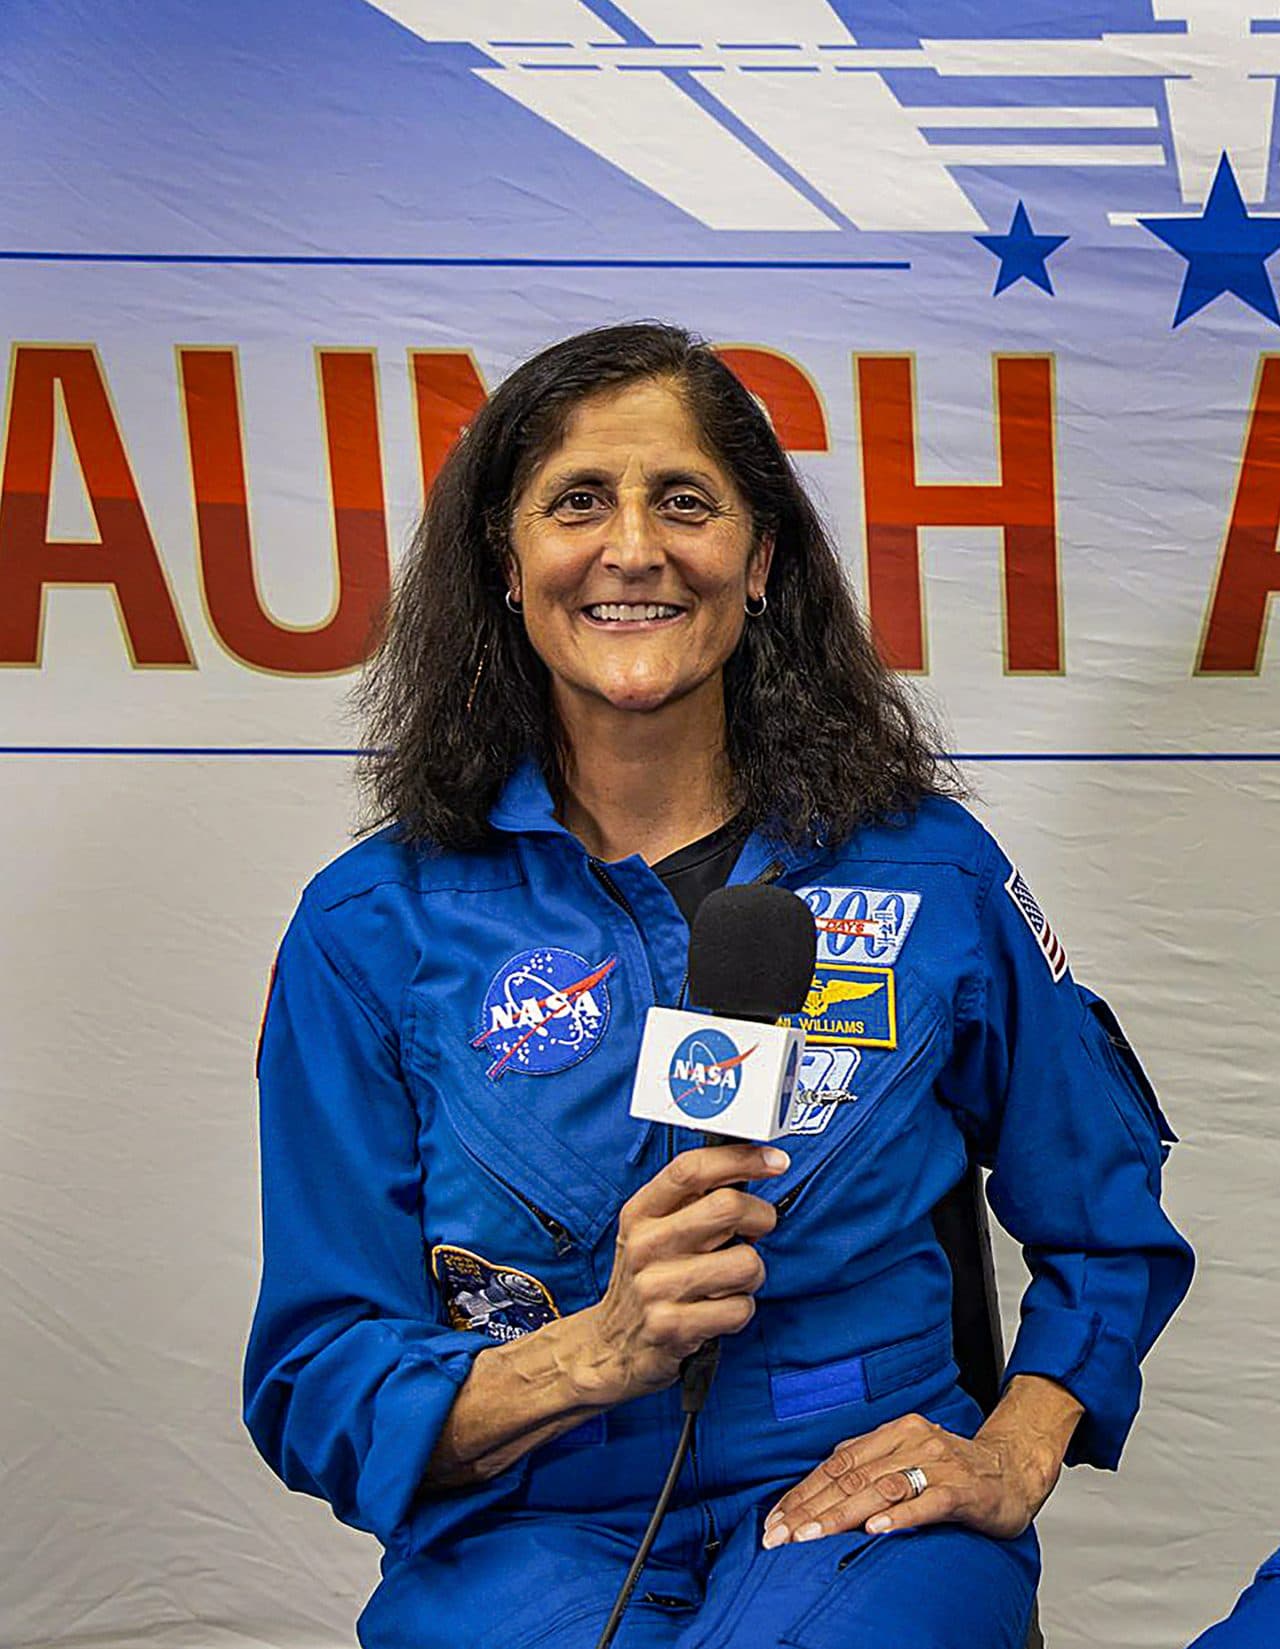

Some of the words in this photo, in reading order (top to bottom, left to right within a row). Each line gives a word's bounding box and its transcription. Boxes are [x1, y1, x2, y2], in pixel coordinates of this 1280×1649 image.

[826, 920, 864, 934] DAYS
[489, 990, 602, 1032] NASA
[798, 1018, 864, 1034] WILLIAMS
[673, 1059, 737, 1089] NASA
